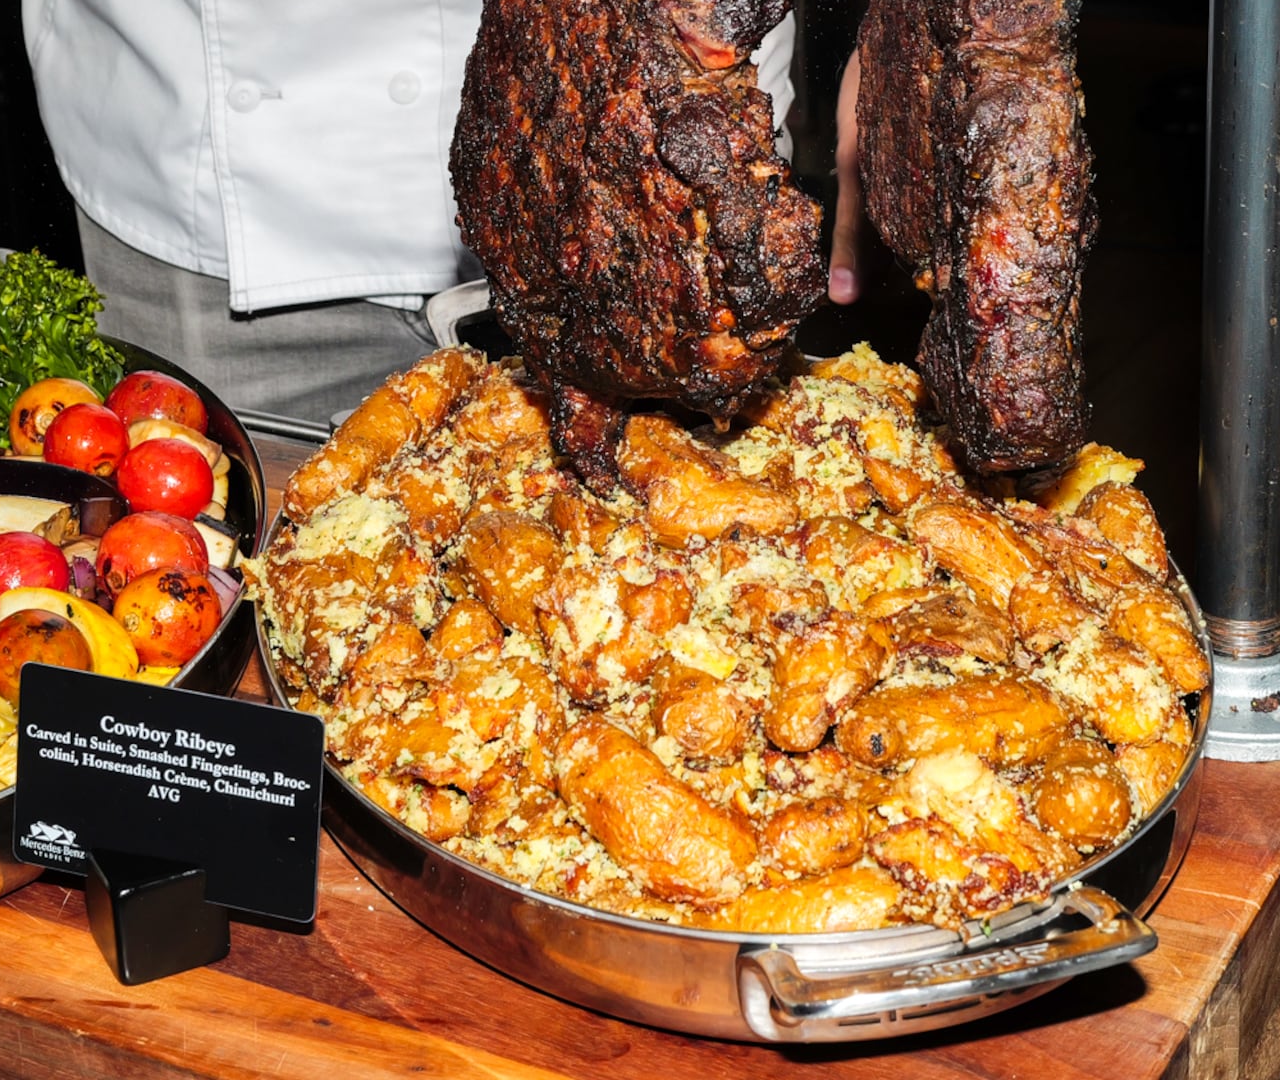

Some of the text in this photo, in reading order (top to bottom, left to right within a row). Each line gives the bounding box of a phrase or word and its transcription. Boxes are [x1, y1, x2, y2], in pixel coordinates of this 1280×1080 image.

[26, 723, 311, 791] Carved in Suite, Smashed Fingerlings, Broc-
[100, 715, 236, 759] Cowboy Ribeye
[39, 747, 296, 807] colini, Horseradish Crème, Chimichurri
[147, 784, 181, 803] AVG
[20, 835, 86, 860] Mercedes-Benz
